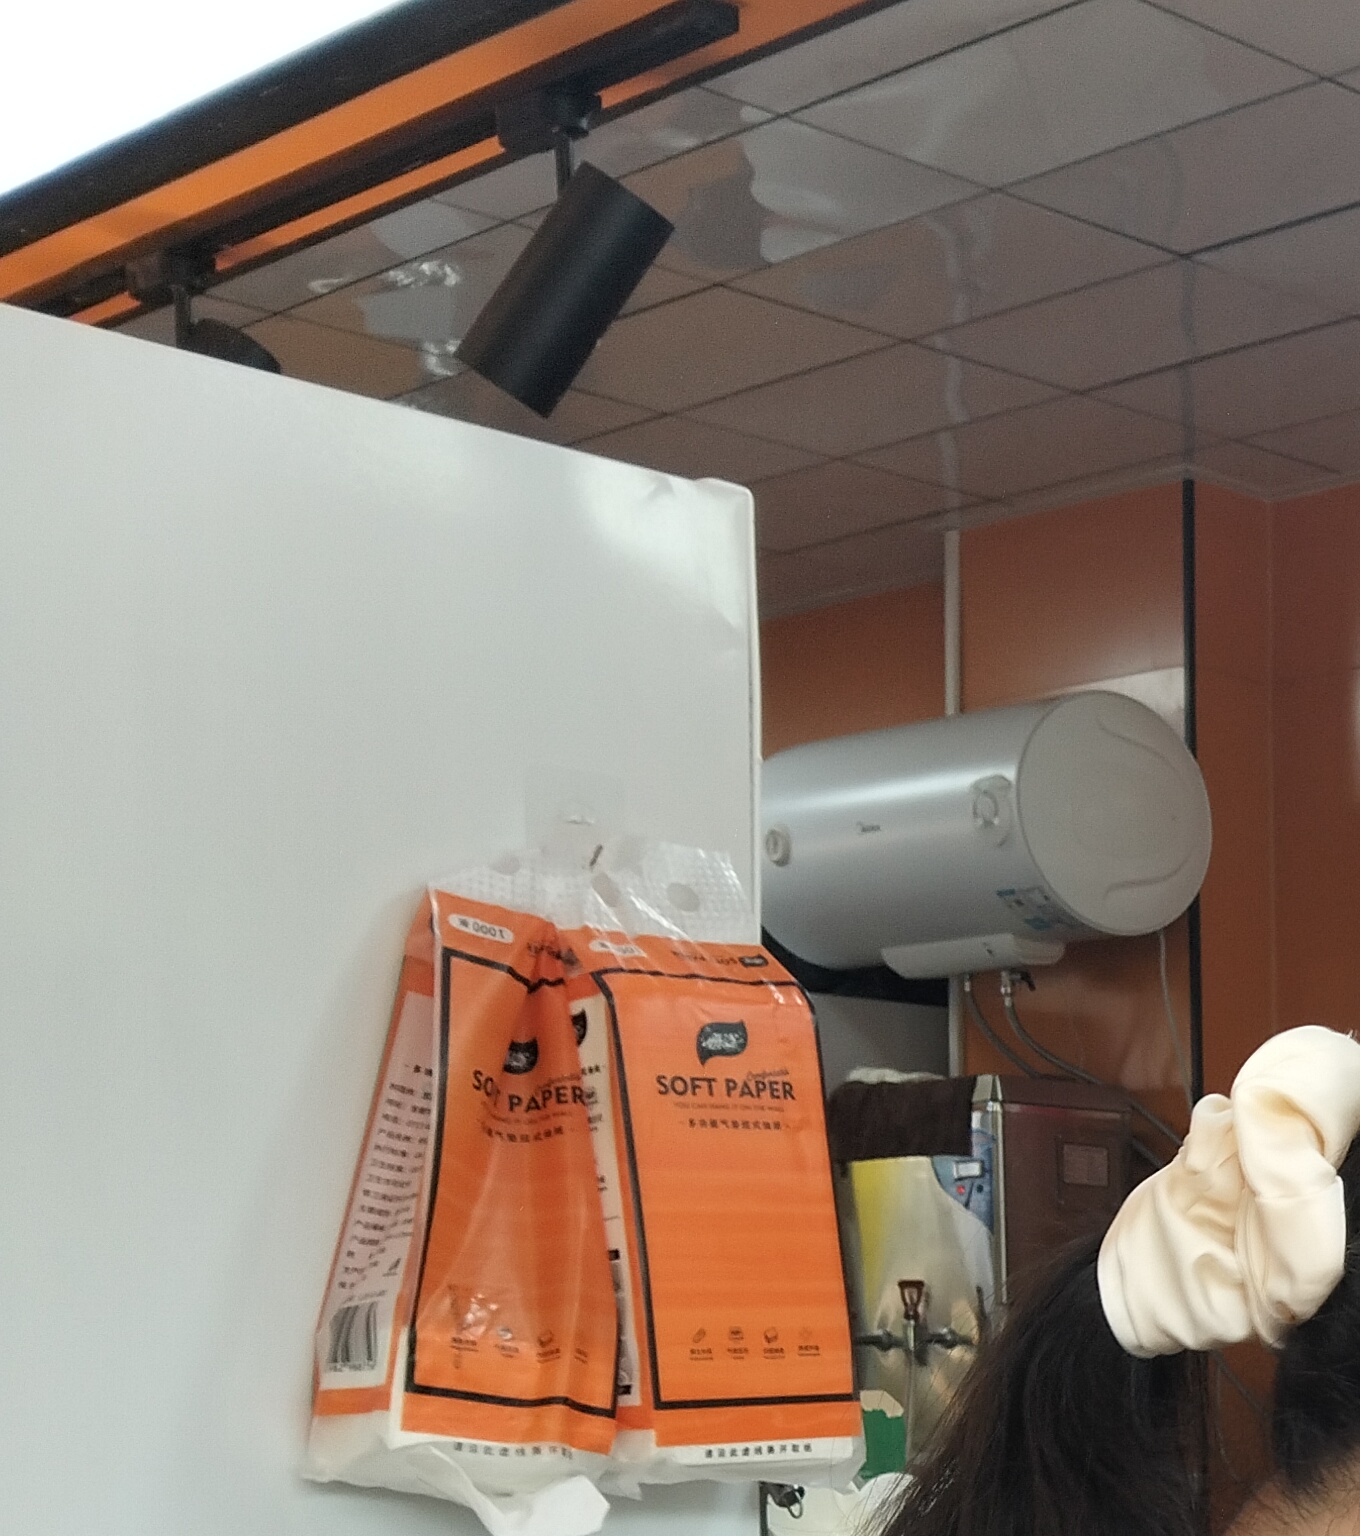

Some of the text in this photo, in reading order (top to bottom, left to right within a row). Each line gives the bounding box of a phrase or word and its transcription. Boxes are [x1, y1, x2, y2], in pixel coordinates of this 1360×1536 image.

[508, 1085, 586, 1113] PAPER
[656, 1075, 796, 1101] SOFT PAPER
